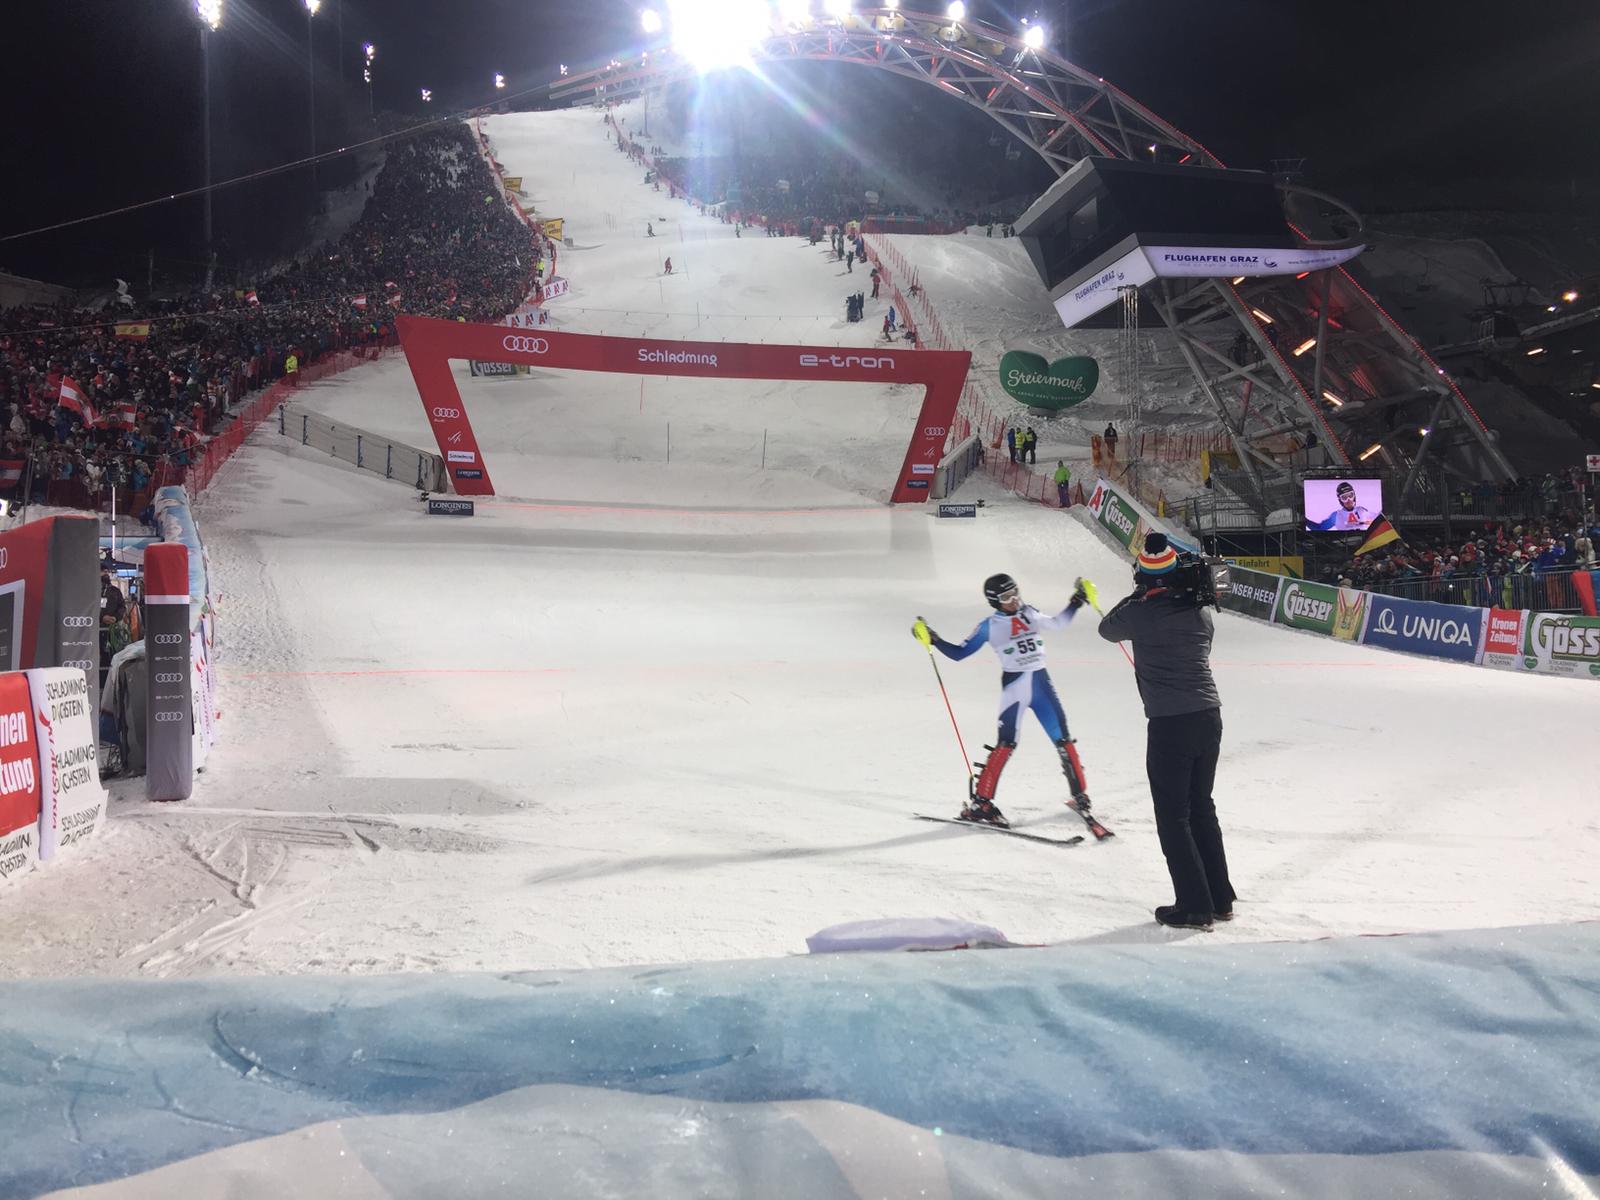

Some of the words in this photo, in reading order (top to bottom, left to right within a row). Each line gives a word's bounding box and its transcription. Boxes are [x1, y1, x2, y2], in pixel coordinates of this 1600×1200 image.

[1164, 254, 1227, 263] FLUGHAFEN
[1230, 255, 1259, 264] GRAZ
[511, 315, 520, 328] A1
[525, 313, 534, 326] A1
[539, 311, 547, 325] A1
[637, 348, 718, 367] Schladming
[800, 354, 895, 369] e-tron
[1007, 369, 1087, 393] Steiermark
[431, 501, 472, 510] LONGINES
[1089, 486, 1108, 512] A1
[1238, 559, 1271, 568] Einfahrt
[1231, 583, 1253, 599] NSER
[1283, 582, 1333, 621] Gösser
[1010, 612, 1031, 637] A1
[1403, 615, 1473, 647] UNIQA
[1491, 617, 1518, 631] Kronen
[1016, 638, 1036, 654] 55
[1489, 631, 1517, 646] Zeitung
